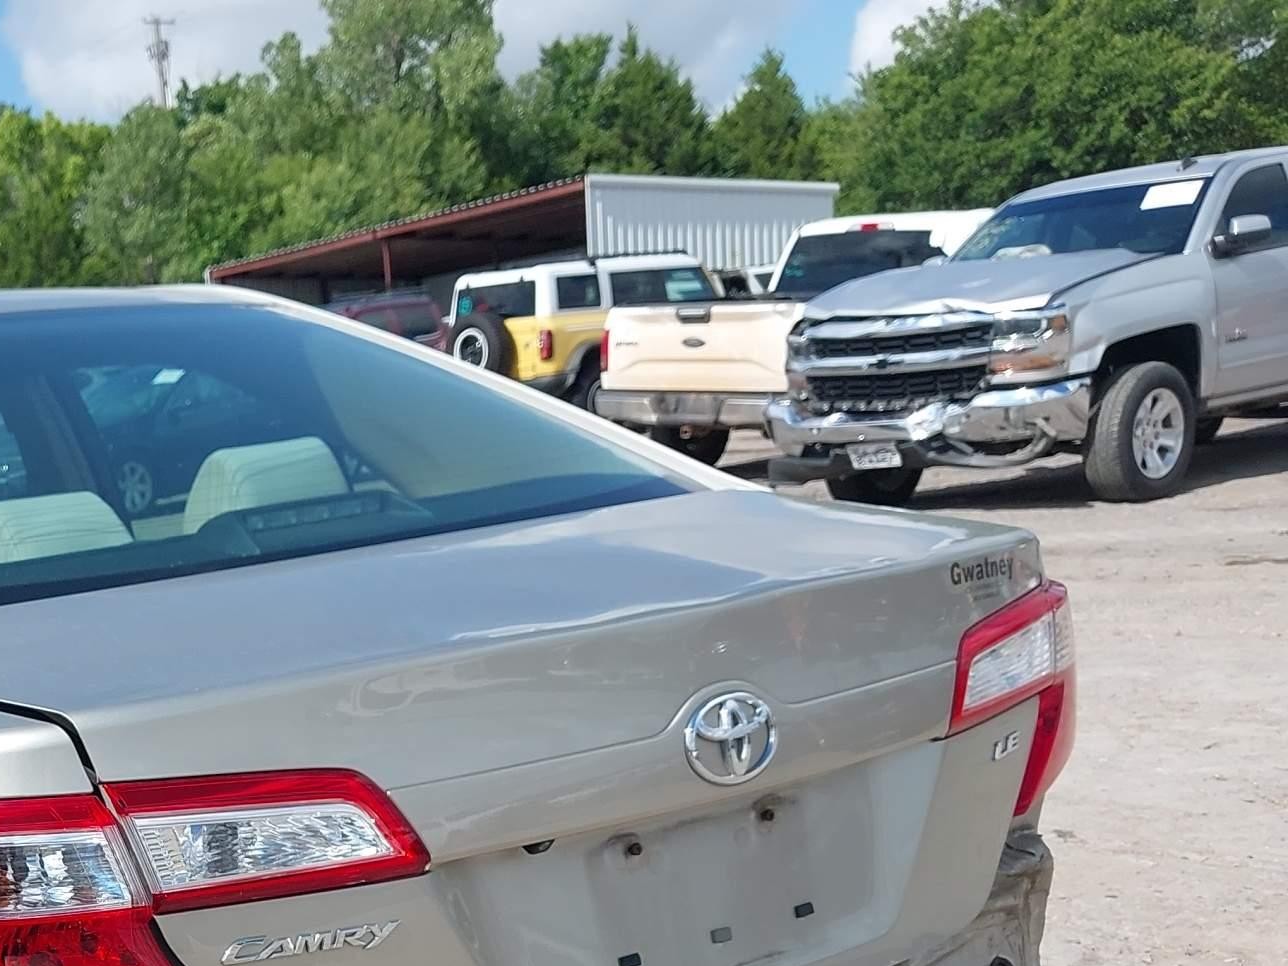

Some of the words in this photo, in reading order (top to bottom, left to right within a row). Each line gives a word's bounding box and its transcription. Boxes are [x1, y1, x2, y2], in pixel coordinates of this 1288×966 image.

[950, 556, 1014, 586] Gwatney
[992, 730, 1020, 761] LE
[220, 919, 402, 966] CAMRY
